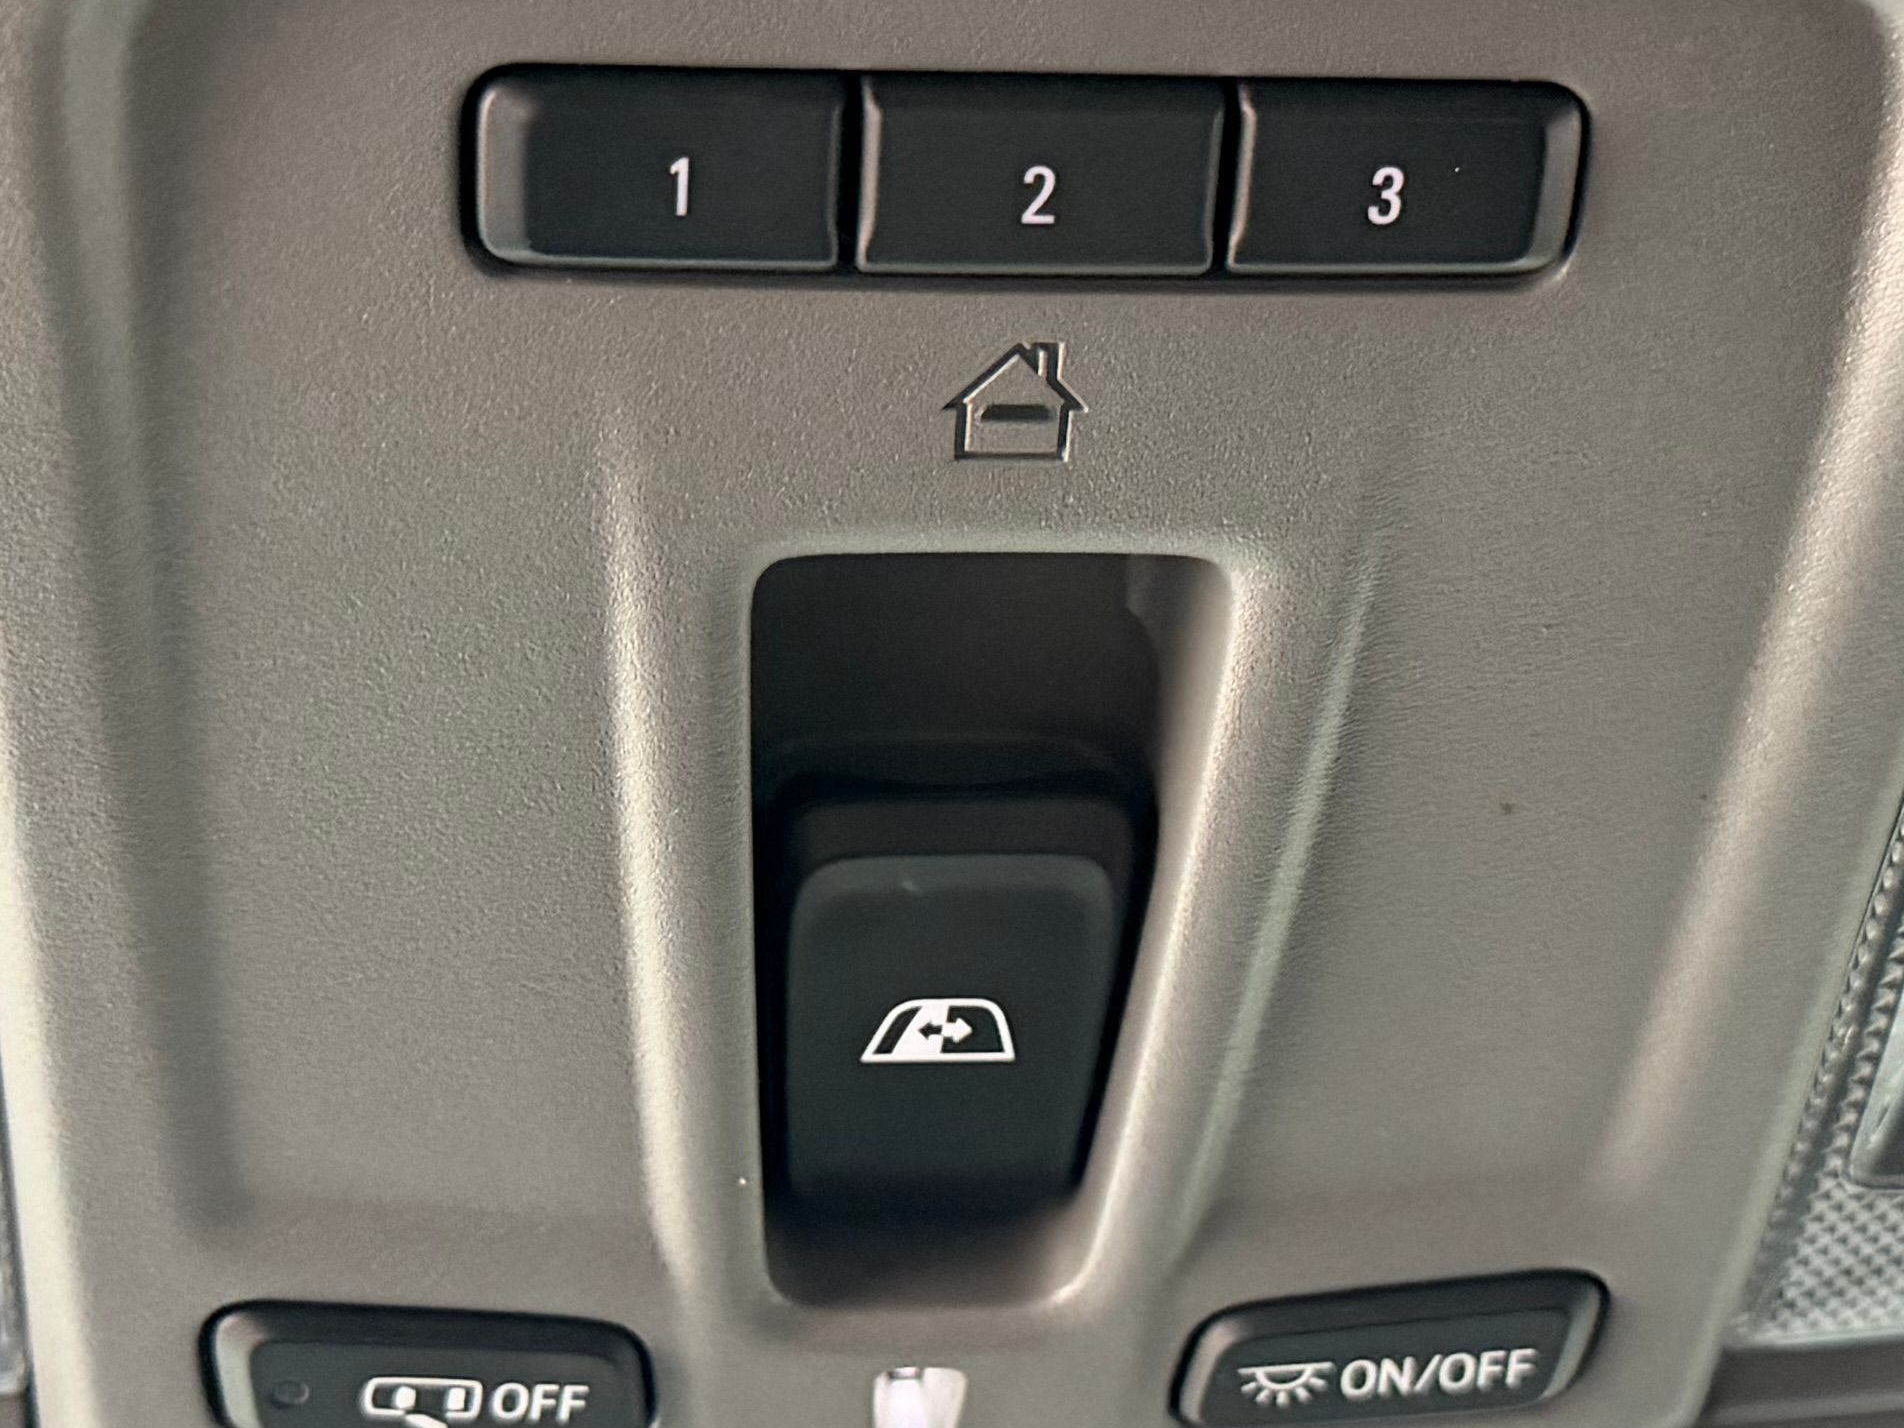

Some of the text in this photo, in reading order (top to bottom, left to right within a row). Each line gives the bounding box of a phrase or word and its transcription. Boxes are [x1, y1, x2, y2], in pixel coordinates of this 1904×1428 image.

[668, 156, 692, 217] 1
[1020, 165, 1056, 225] 2
[1366, 166, 1406, 225] 3
[490, 1382, 590, 1424] OFF
[1340, 1348, 1539, 1400] ON/OFF
